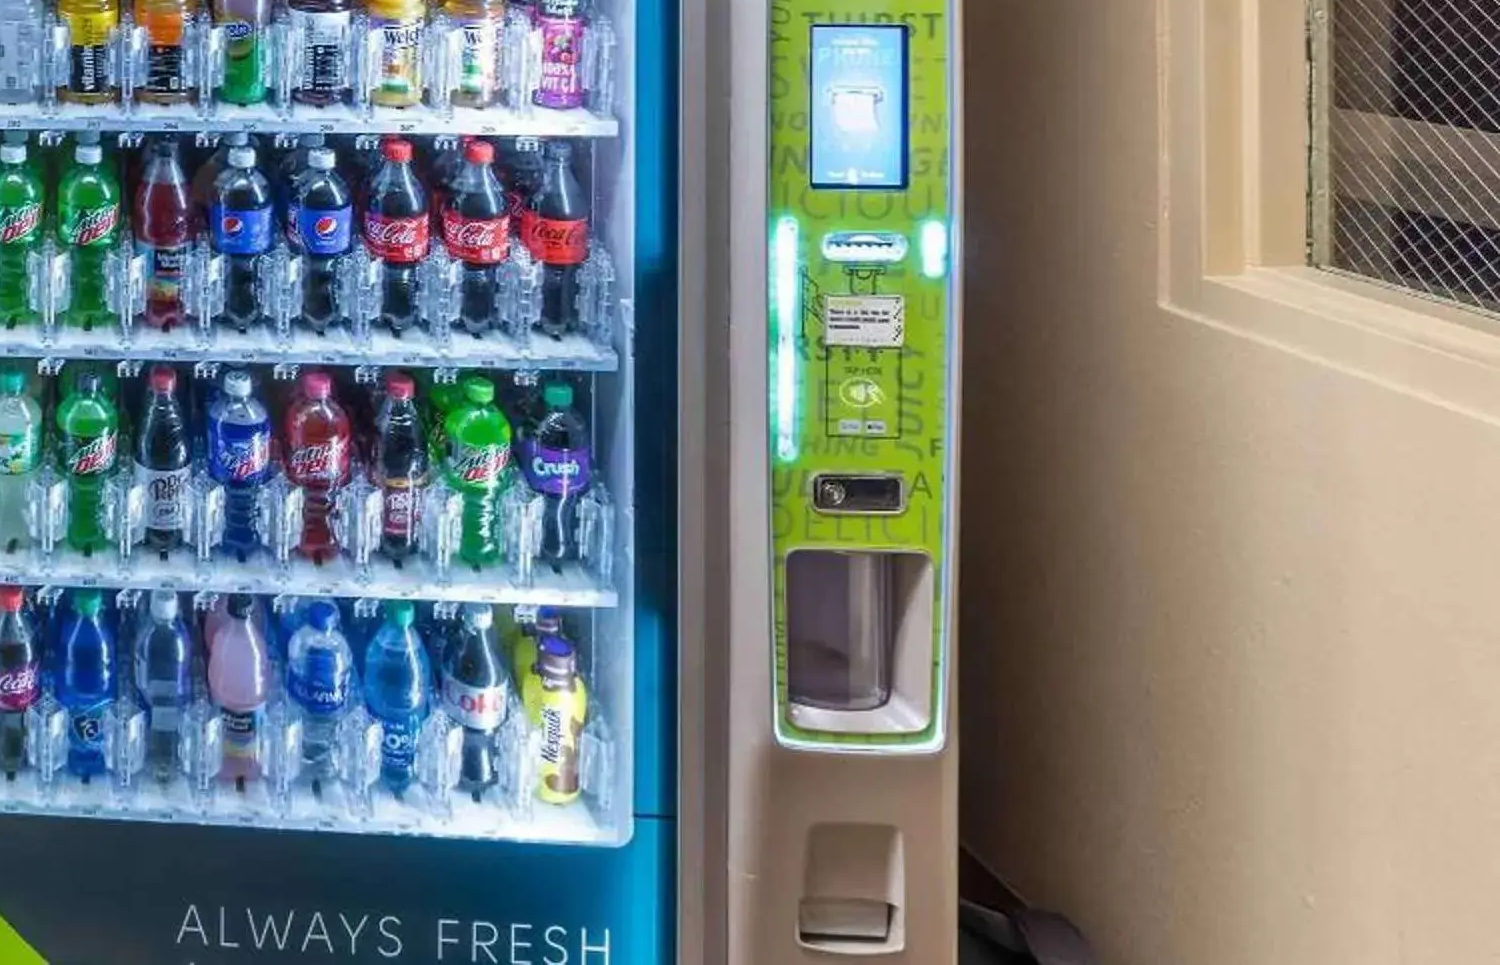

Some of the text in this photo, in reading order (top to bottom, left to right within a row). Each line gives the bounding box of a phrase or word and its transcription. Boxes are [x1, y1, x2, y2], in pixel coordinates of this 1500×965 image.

[532, 459, 580, 477] Crush
[540, 708, 563, 763] Nesquik
[176, 904, 611, 965] ALWAYS FRESH
